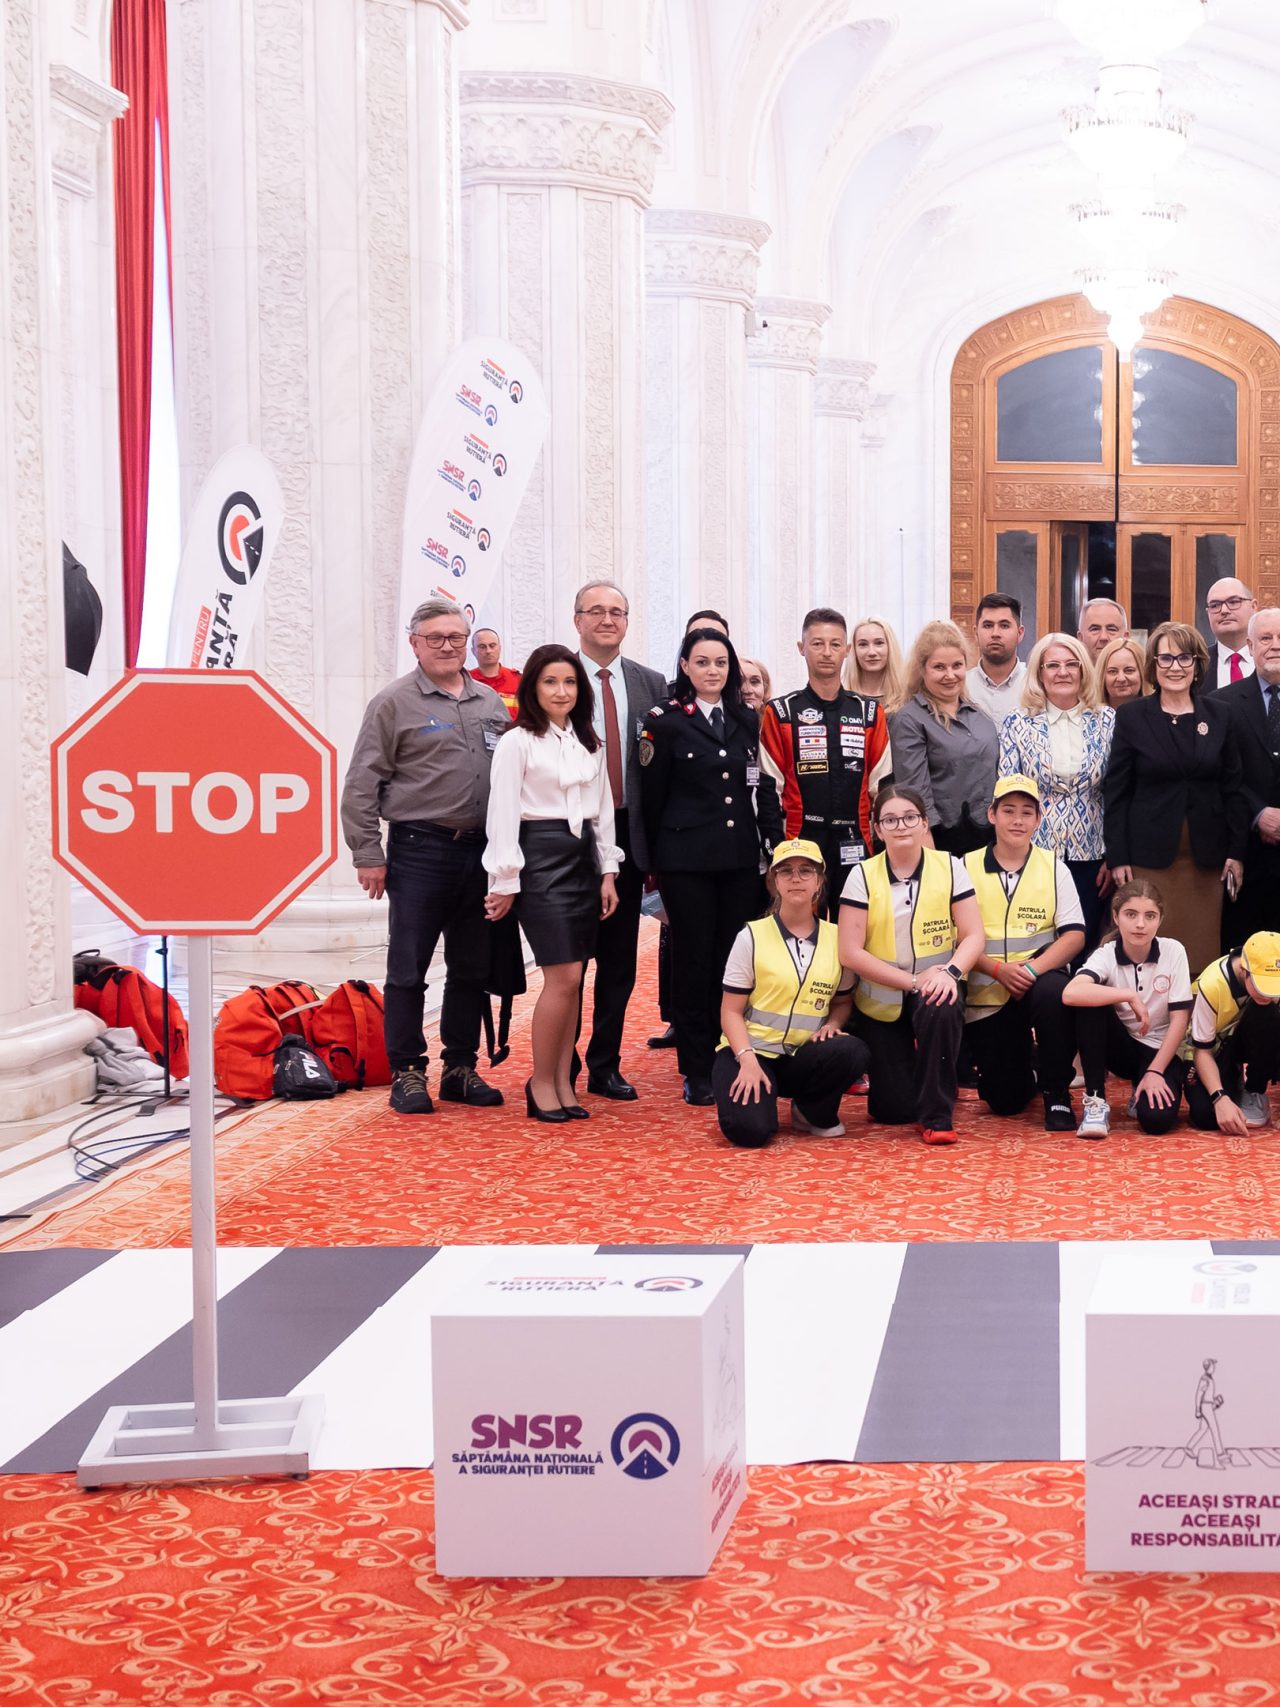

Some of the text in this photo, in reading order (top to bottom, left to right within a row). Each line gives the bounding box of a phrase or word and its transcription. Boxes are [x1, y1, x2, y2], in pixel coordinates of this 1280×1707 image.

[80, 770, 310, 834] STOP
[1018, 906, 1046, 914] PATRULA
[923, 919, 949, 928] PATRULA
[470, 1414, 583, 1450] SNSR
[451, 1451, 604, 1467] SĂPTĂMÂNA NAȚIONALĂ
[458, 1465, 595, 1478] A SIGURANȚEI RUTIERE
[1138, 1494, 1218, 1512] ACEEAȘI
[1181, 1514, 1260, 1532] ACEEAȘI
